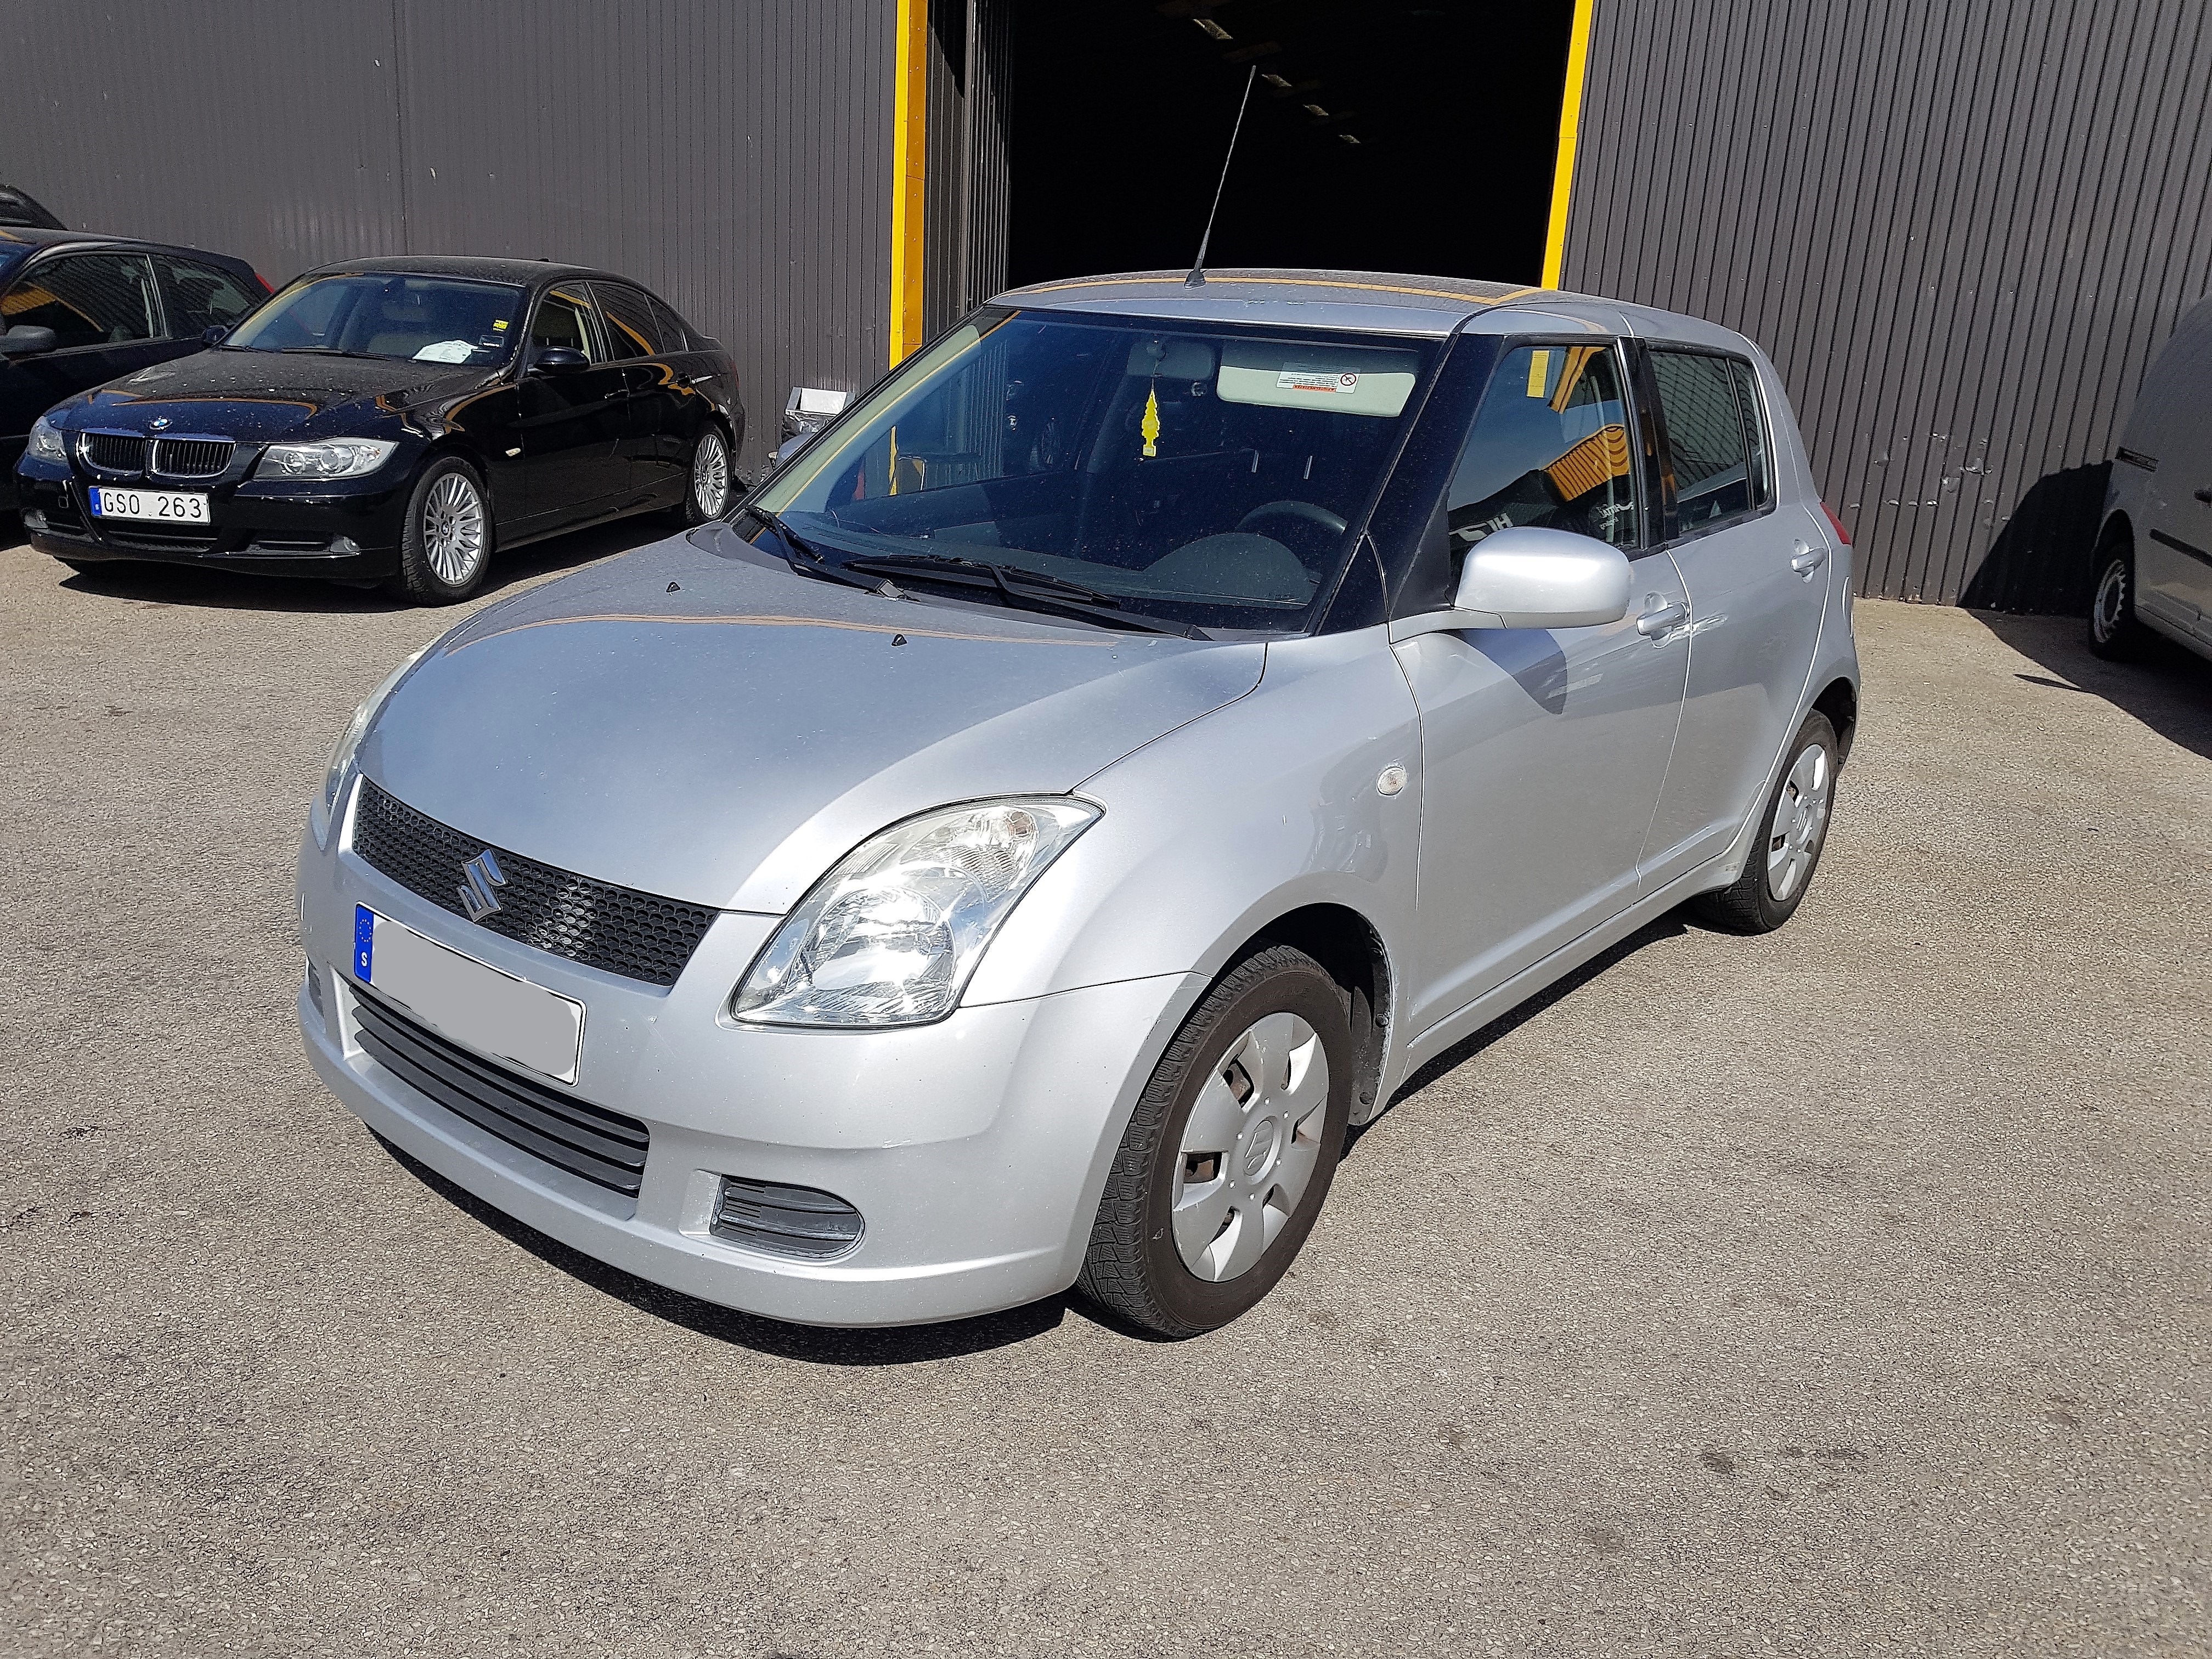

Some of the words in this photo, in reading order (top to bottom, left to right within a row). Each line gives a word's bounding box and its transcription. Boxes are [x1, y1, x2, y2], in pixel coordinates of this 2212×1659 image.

[104, 493, 140, 515] GSO
[157, 496, 202, 518] 263
[361, 952, 368, 967] S
